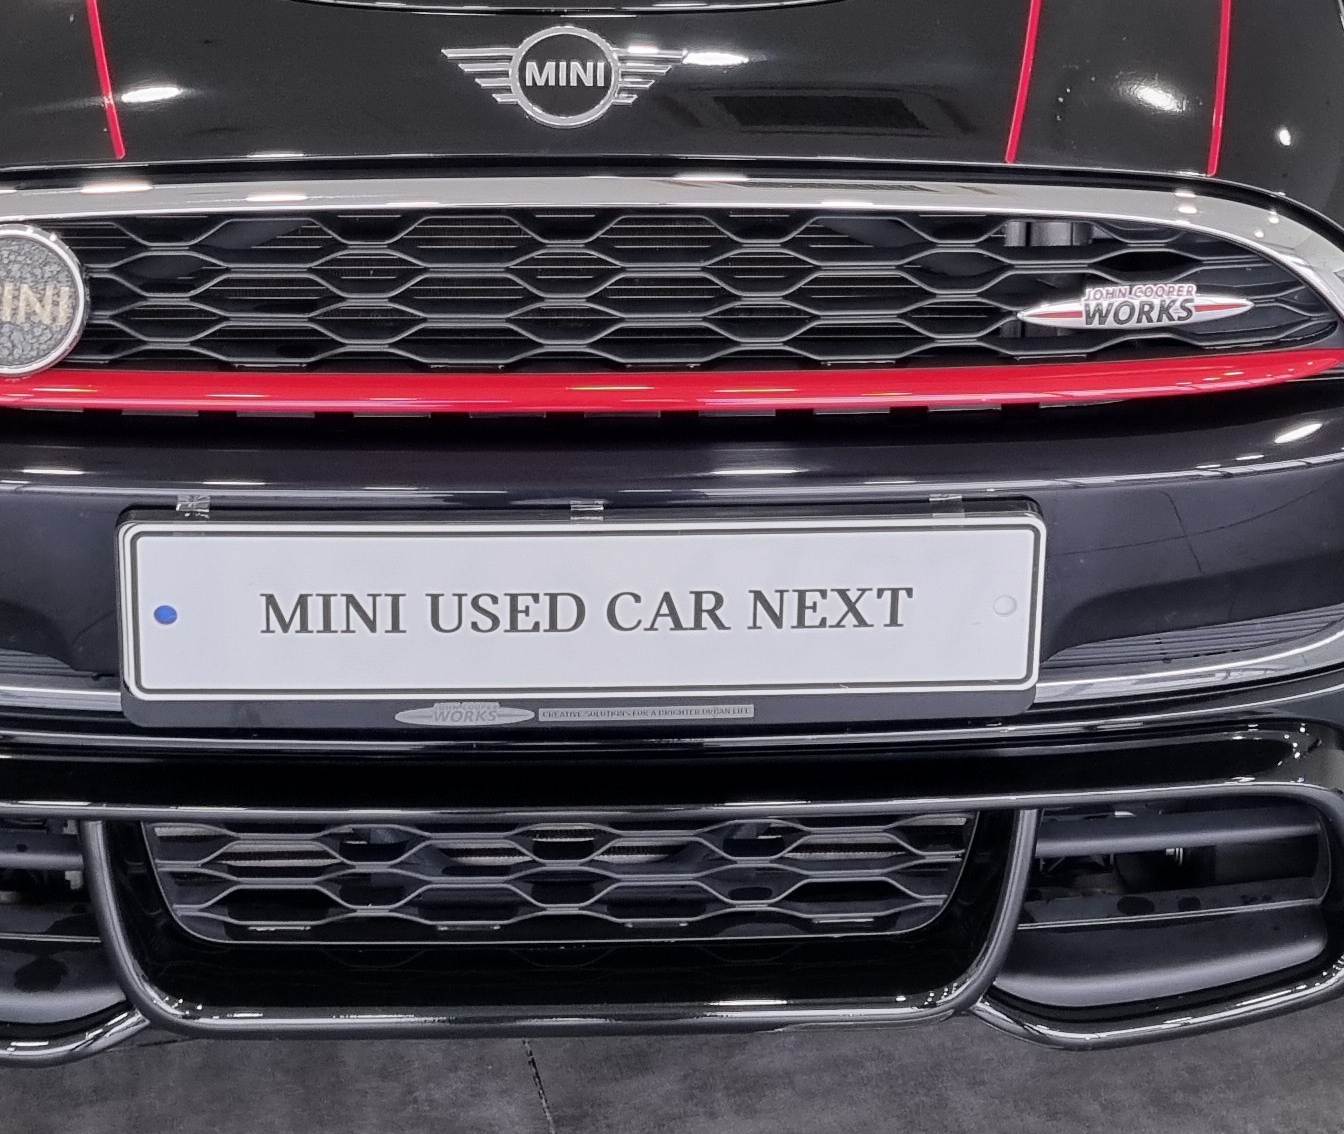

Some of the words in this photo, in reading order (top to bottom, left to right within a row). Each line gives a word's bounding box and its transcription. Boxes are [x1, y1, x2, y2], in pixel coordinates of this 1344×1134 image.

[524, 61, 606, 87] MINI
[1083, 287, 1129, 301] JOHN
[1134, 285, 1197, 299] COOPER
[1082, 297, 1196, 326] WORKS
[259, 593, 406, 634] MINI
[425, 592, 586, 633] USED
[606, 590, 732, 632] CAR
[747, 587, 913, 630] NEXT
[434, 710, 497, 723] WORKS
[542, 710, 581, 718] CREATIVE
[584, 709, 631, 718] SOLUTIONS
[632, 709, 649, 717] FOR
[732, 707, 750, 715] LIFE
